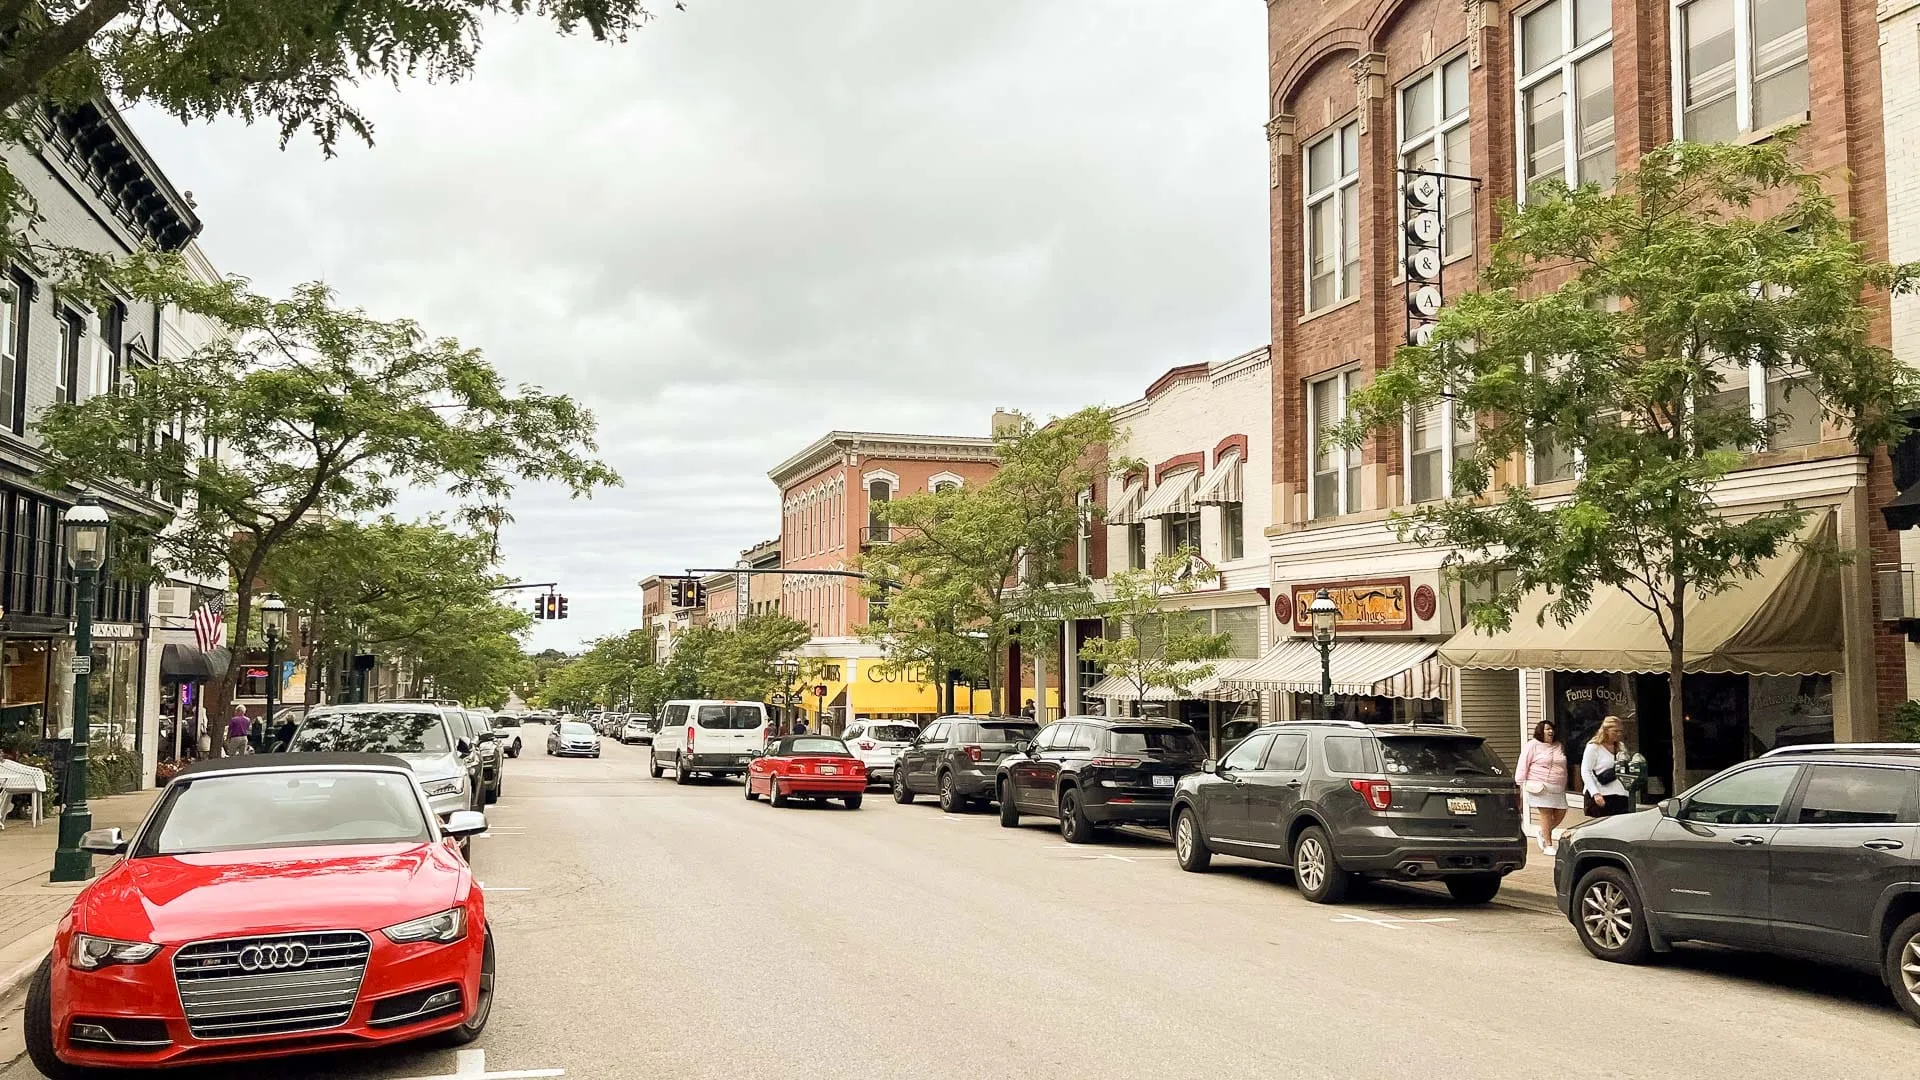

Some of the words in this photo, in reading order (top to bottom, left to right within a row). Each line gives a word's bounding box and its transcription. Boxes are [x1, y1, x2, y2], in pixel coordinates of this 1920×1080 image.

[1423, 220, 1432, 233] F
[1422, 256, 1432, 270] &
[1423, 294, 1433, 307] A
[1565, 688, 1593, 702] Fancy
[1596, 685, 1629, 705] Goods
